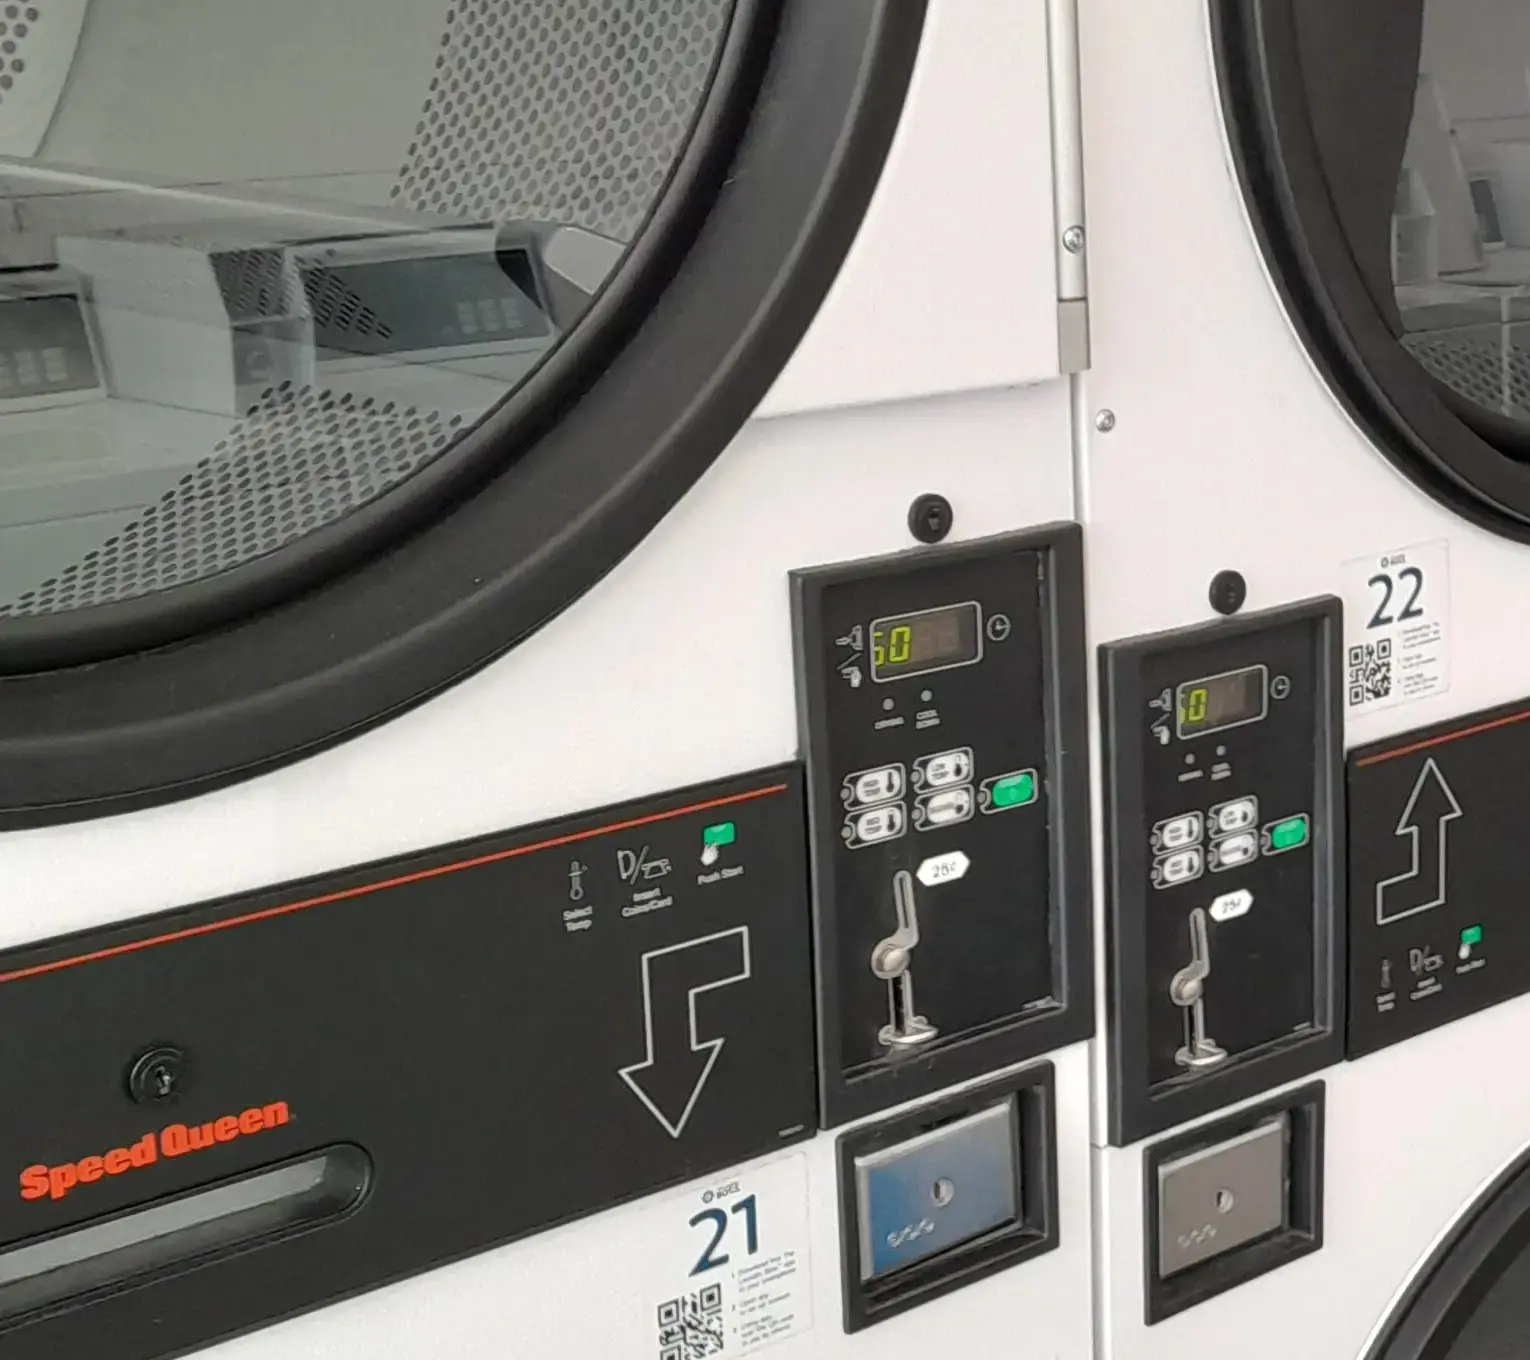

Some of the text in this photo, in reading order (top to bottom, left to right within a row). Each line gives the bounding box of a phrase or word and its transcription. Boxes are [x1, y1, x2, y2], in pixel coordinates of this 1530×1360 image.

[1367, 566, 1424, 629] 22
[20, 1101, 290, 1200] Speed Queen
[688, 1193, 759, 1278] 21
